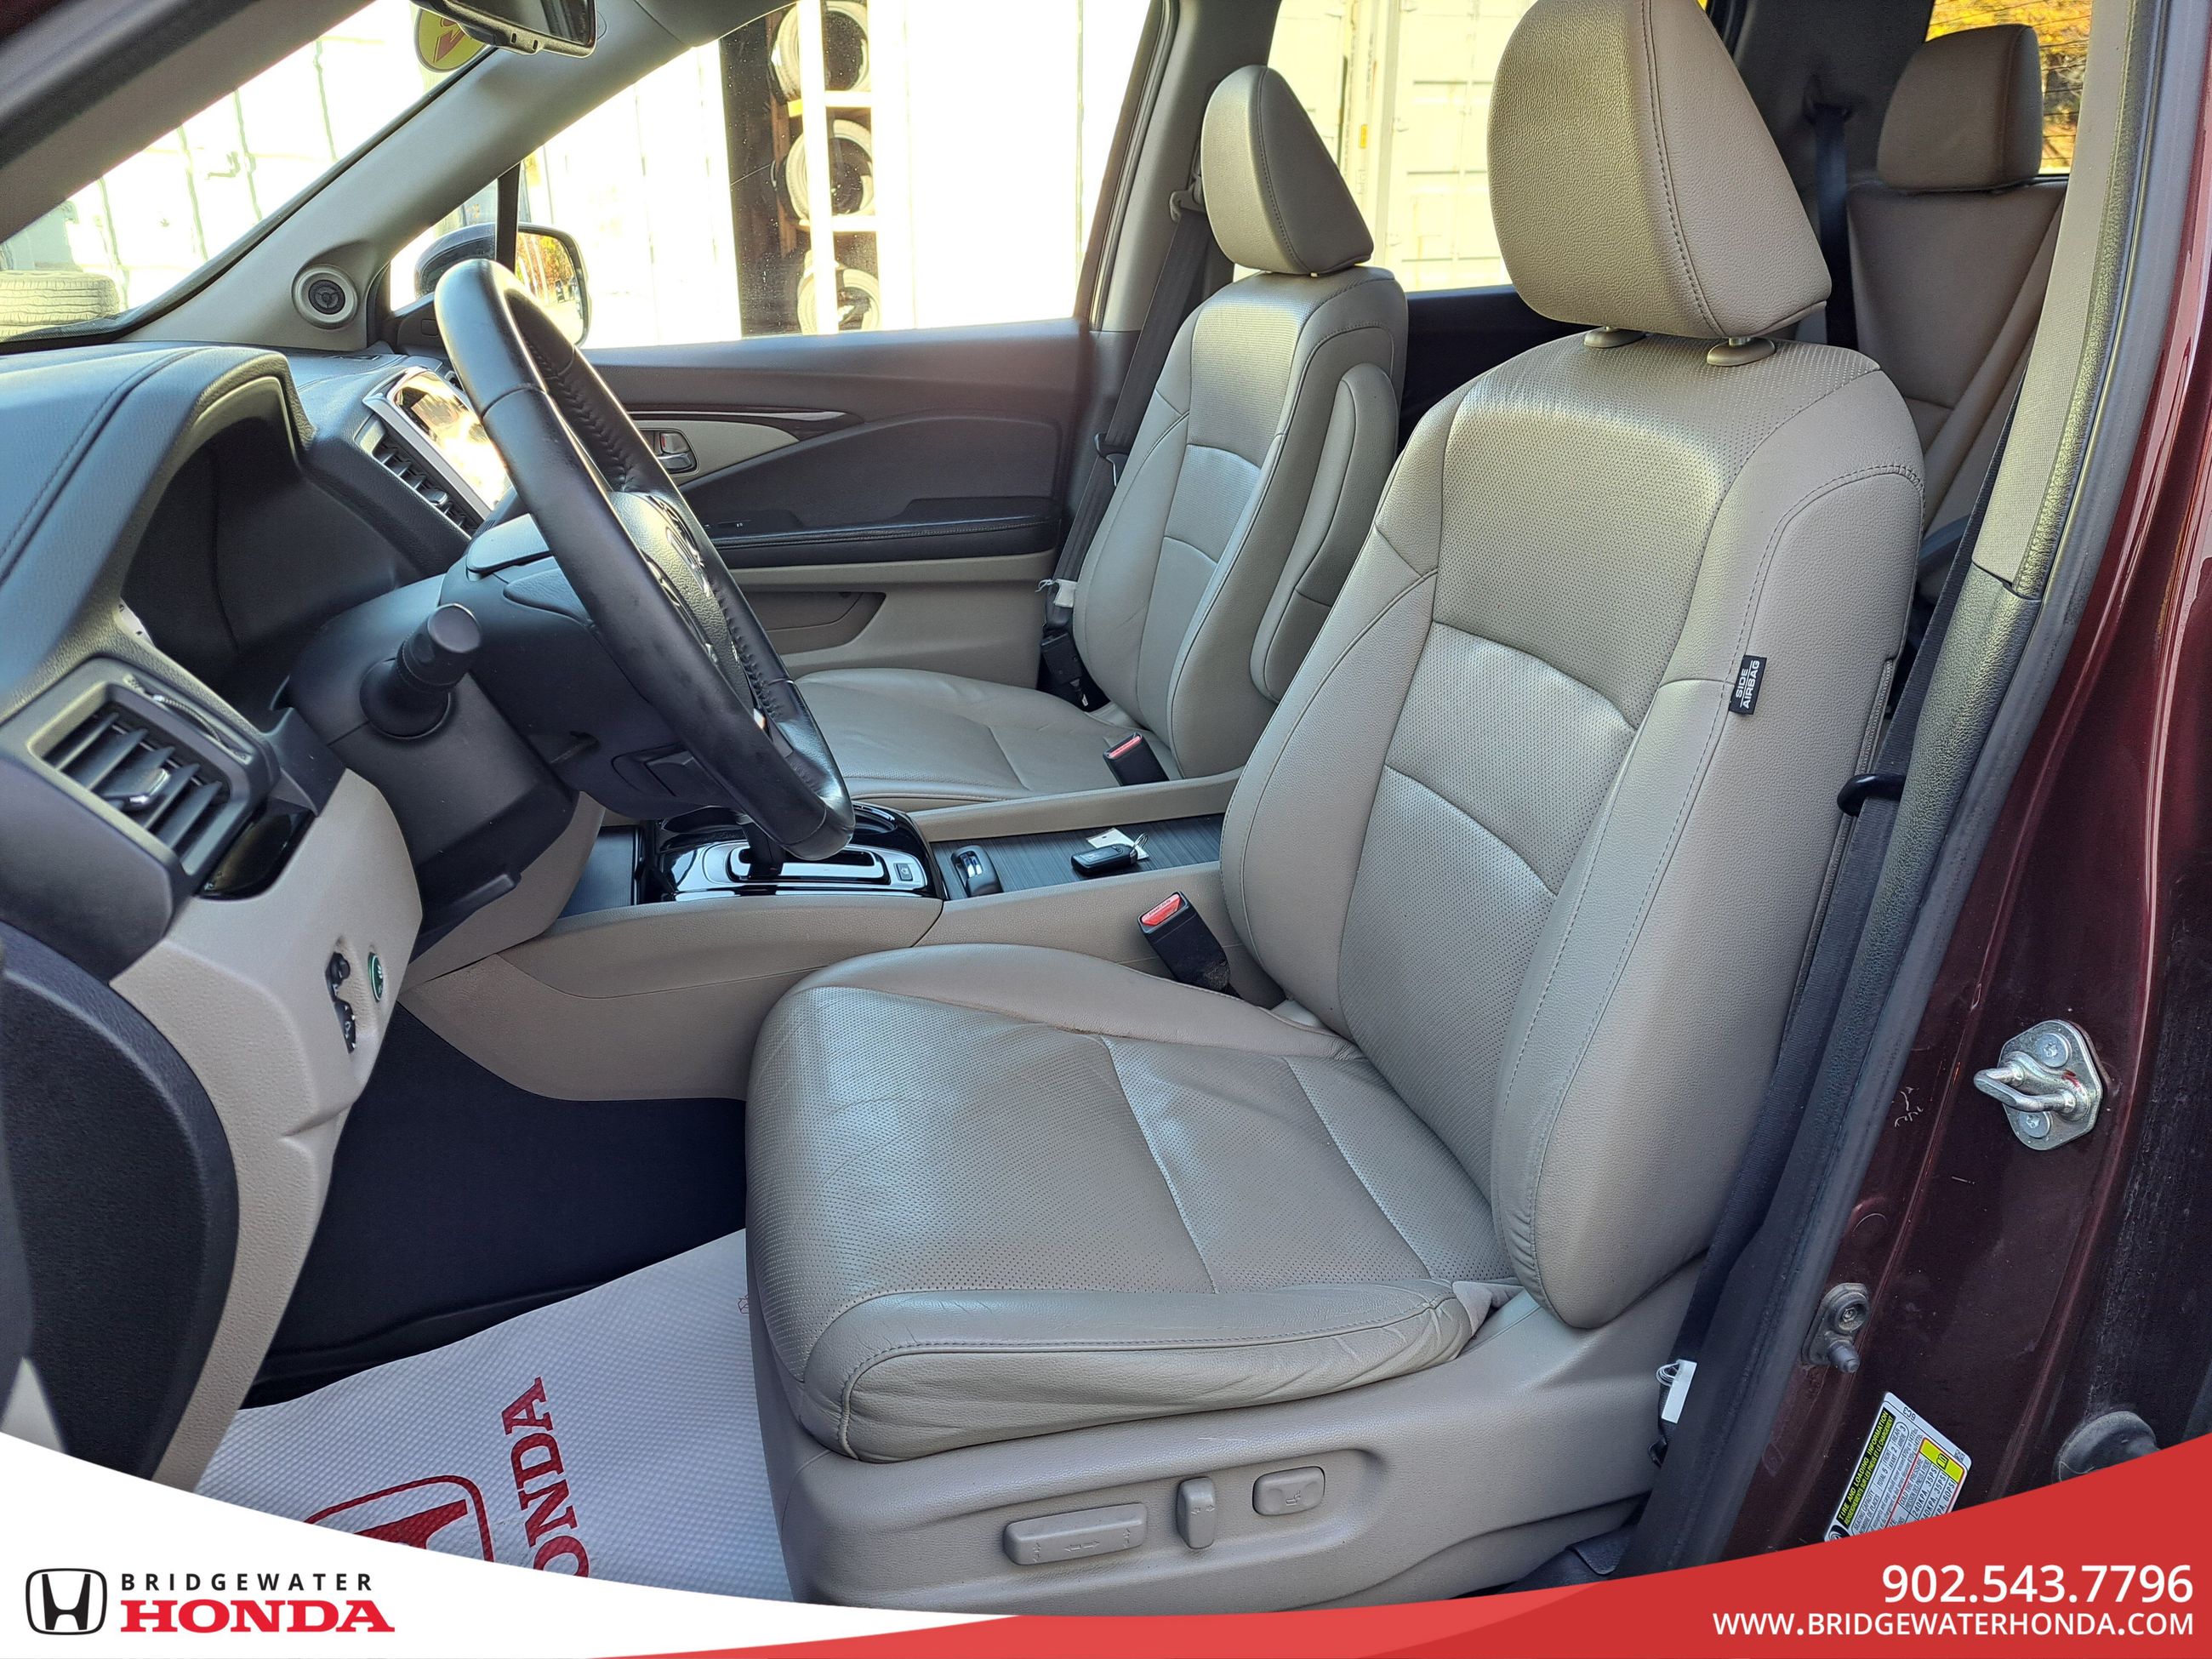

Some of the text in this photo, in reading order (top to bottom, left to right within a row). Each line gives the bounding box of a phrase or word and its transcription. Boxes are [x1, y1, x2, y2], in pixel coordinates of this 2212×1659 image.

[1736, 669, 1747, 698] SIDE
[1743, 660, 1759, 709] AIRBAG
[501, 1377, 589, 1576] ONDA
[1839, 1411, 1888, 1520] TIRE AND LOADING INFORMATION
[1913, 1465, 1937, 1516] 240KPA, 35PSI
[1922, 1473, 1947, 1519] 40KPA, 35PSI
